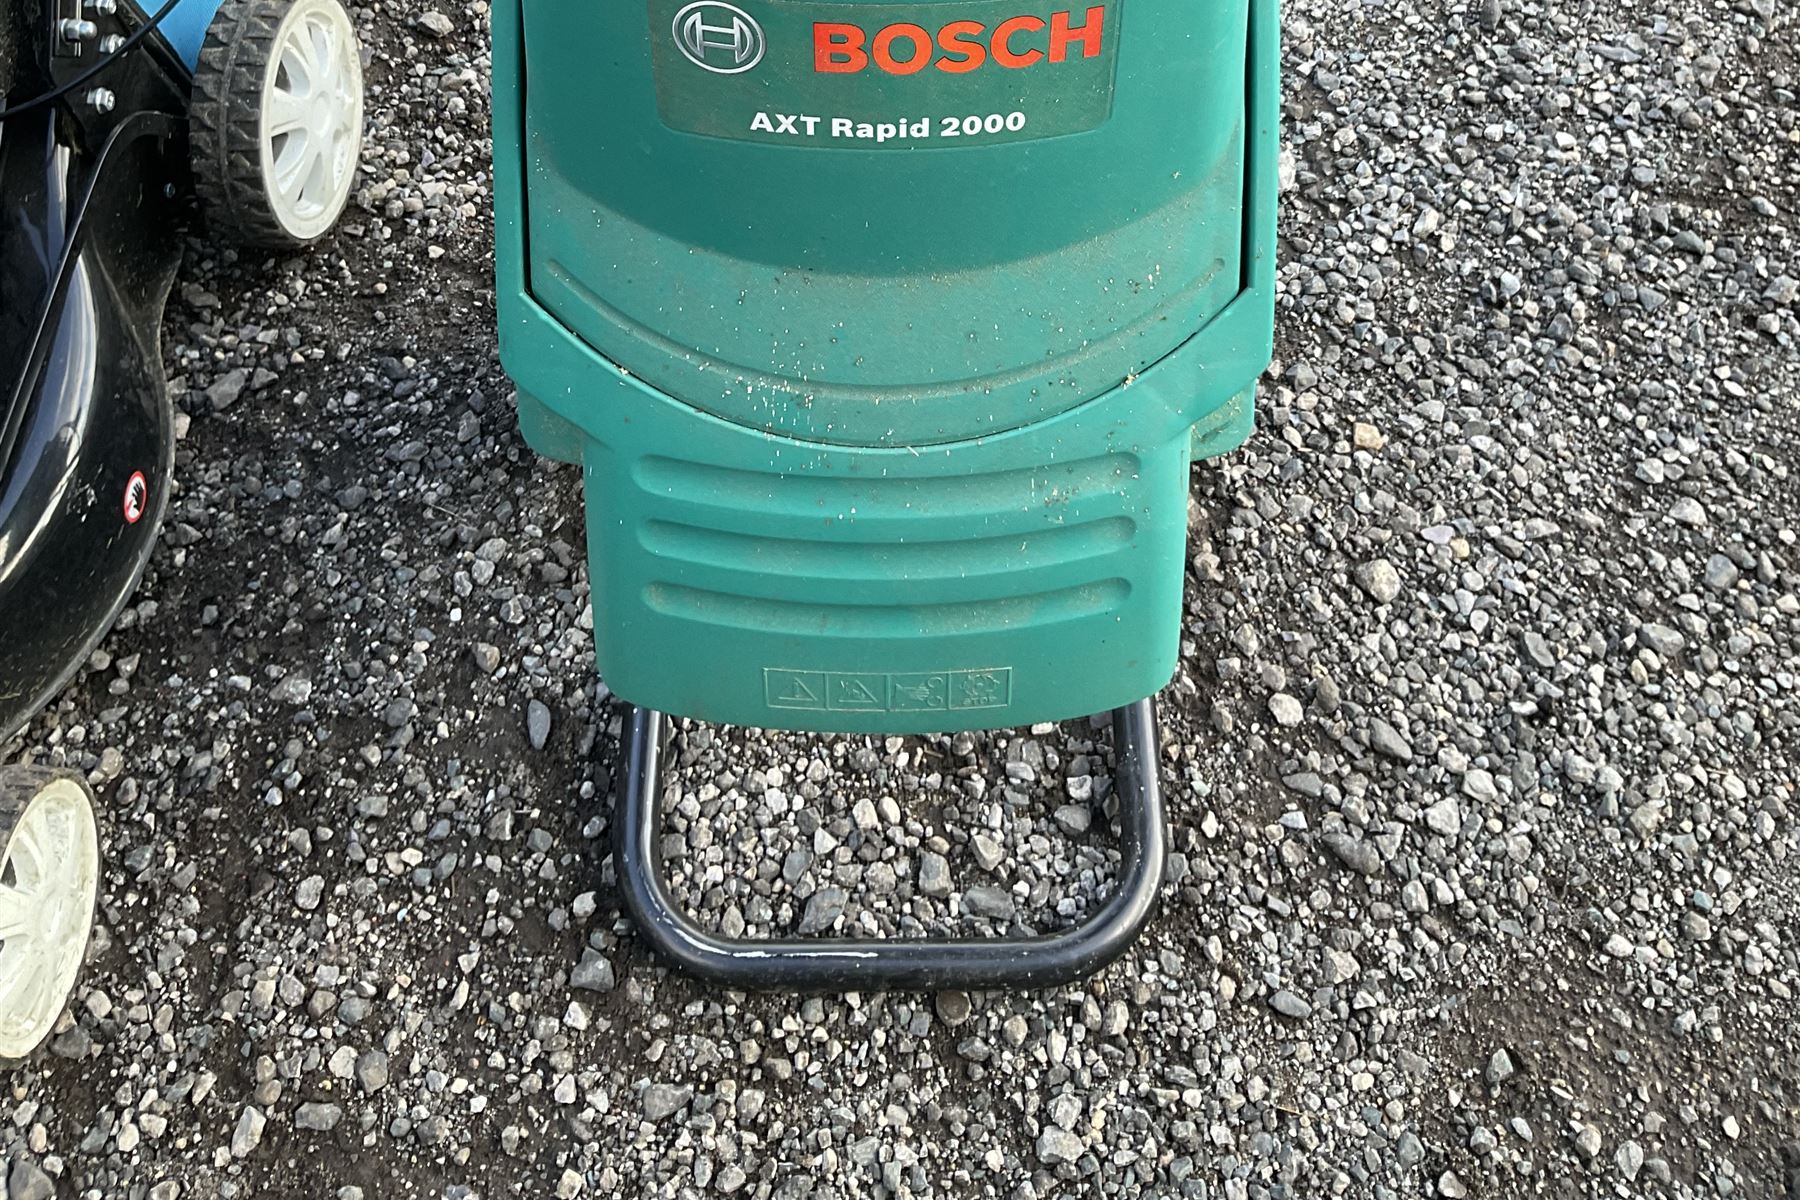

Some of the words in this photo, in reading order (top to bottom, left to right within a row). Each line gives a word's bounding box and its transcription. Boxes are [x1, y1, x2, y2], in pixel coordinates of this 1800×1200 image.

[813, 5, 1105, 75] BOSCH
[750, 112, 820, 137] AXT
[831, 117, 930, 142] Rapid
[940, 111, 1026, 137] 2000
